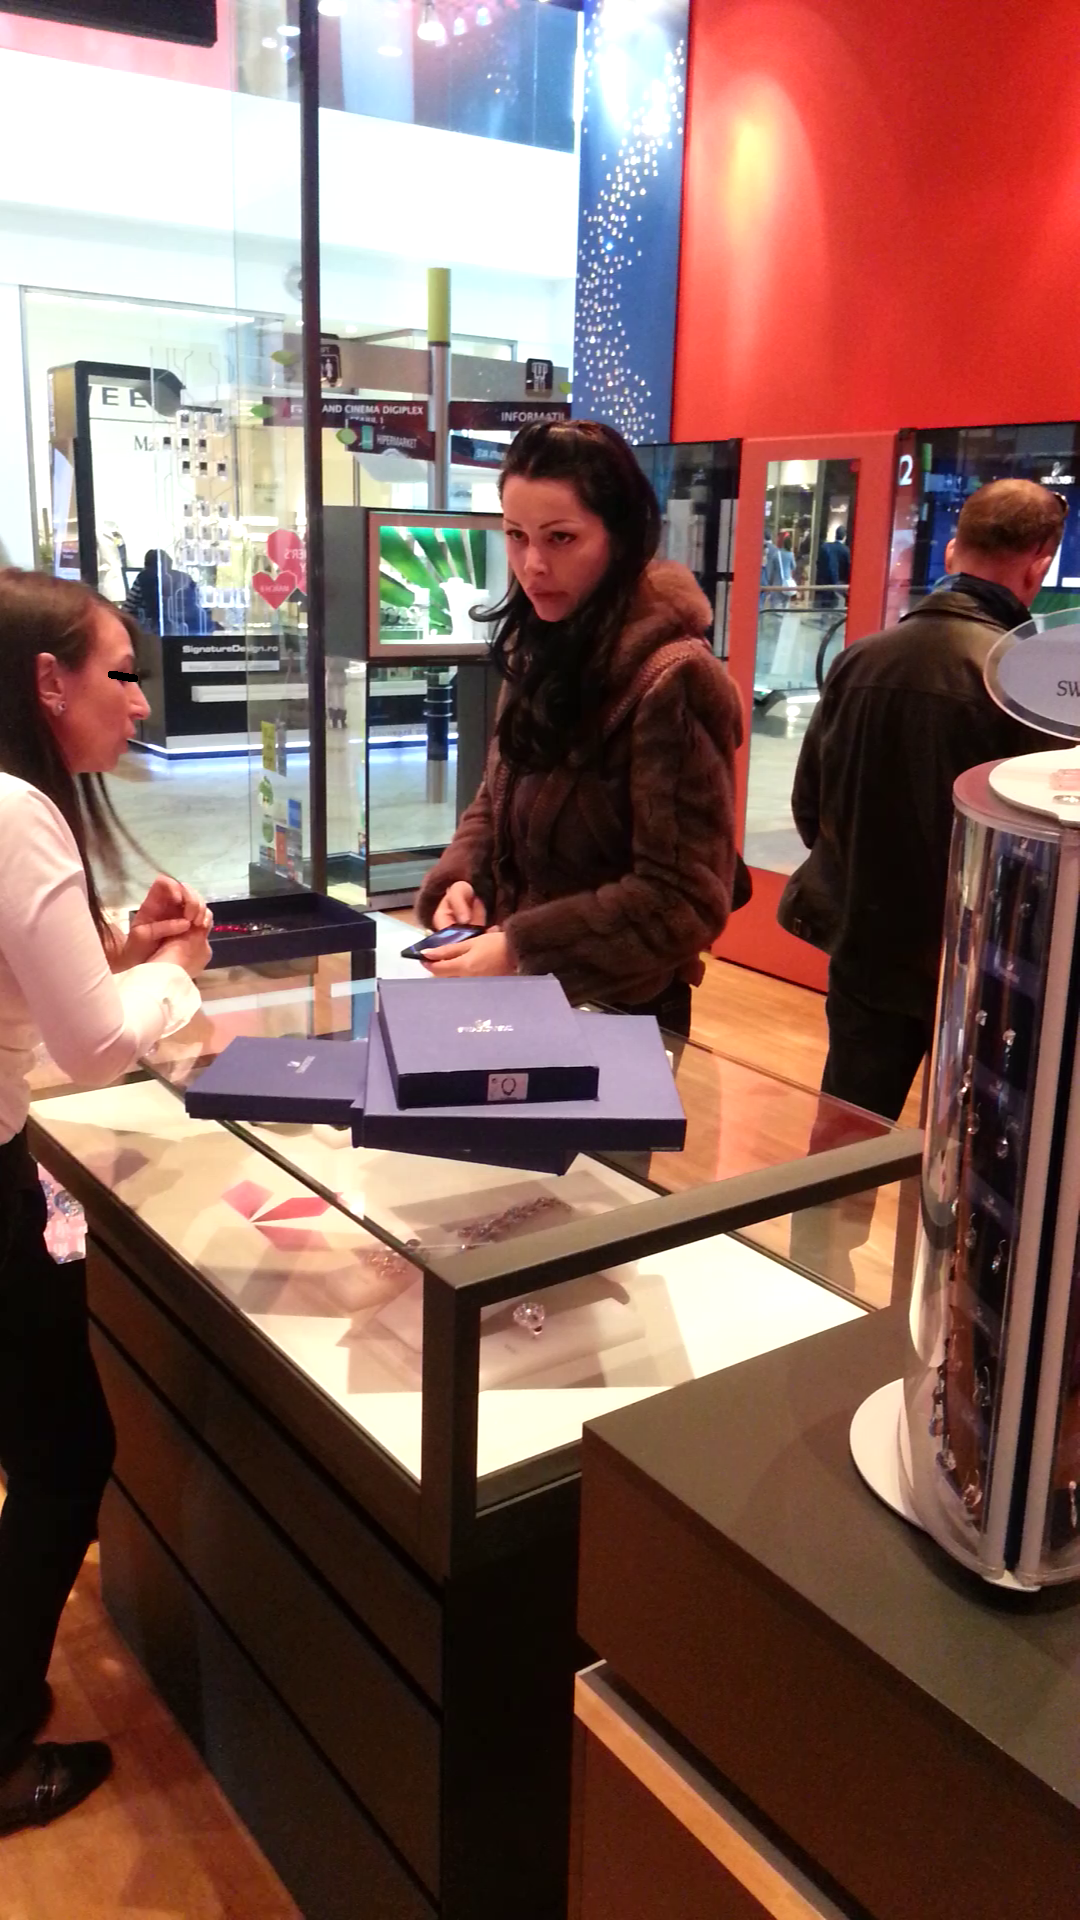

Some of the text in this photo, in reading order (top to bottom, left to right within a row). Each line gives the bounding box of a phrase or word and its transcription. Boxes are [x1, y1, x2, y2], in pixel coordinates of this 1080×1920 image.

[321, 404, 424, 415] AND CINEMA DIGIPLEX
[376, 434, 417, 449] HIPERMARKET
[899, 454, 913, 486] 2
[182, 644, 279, 655] SignatureDesign.ro
